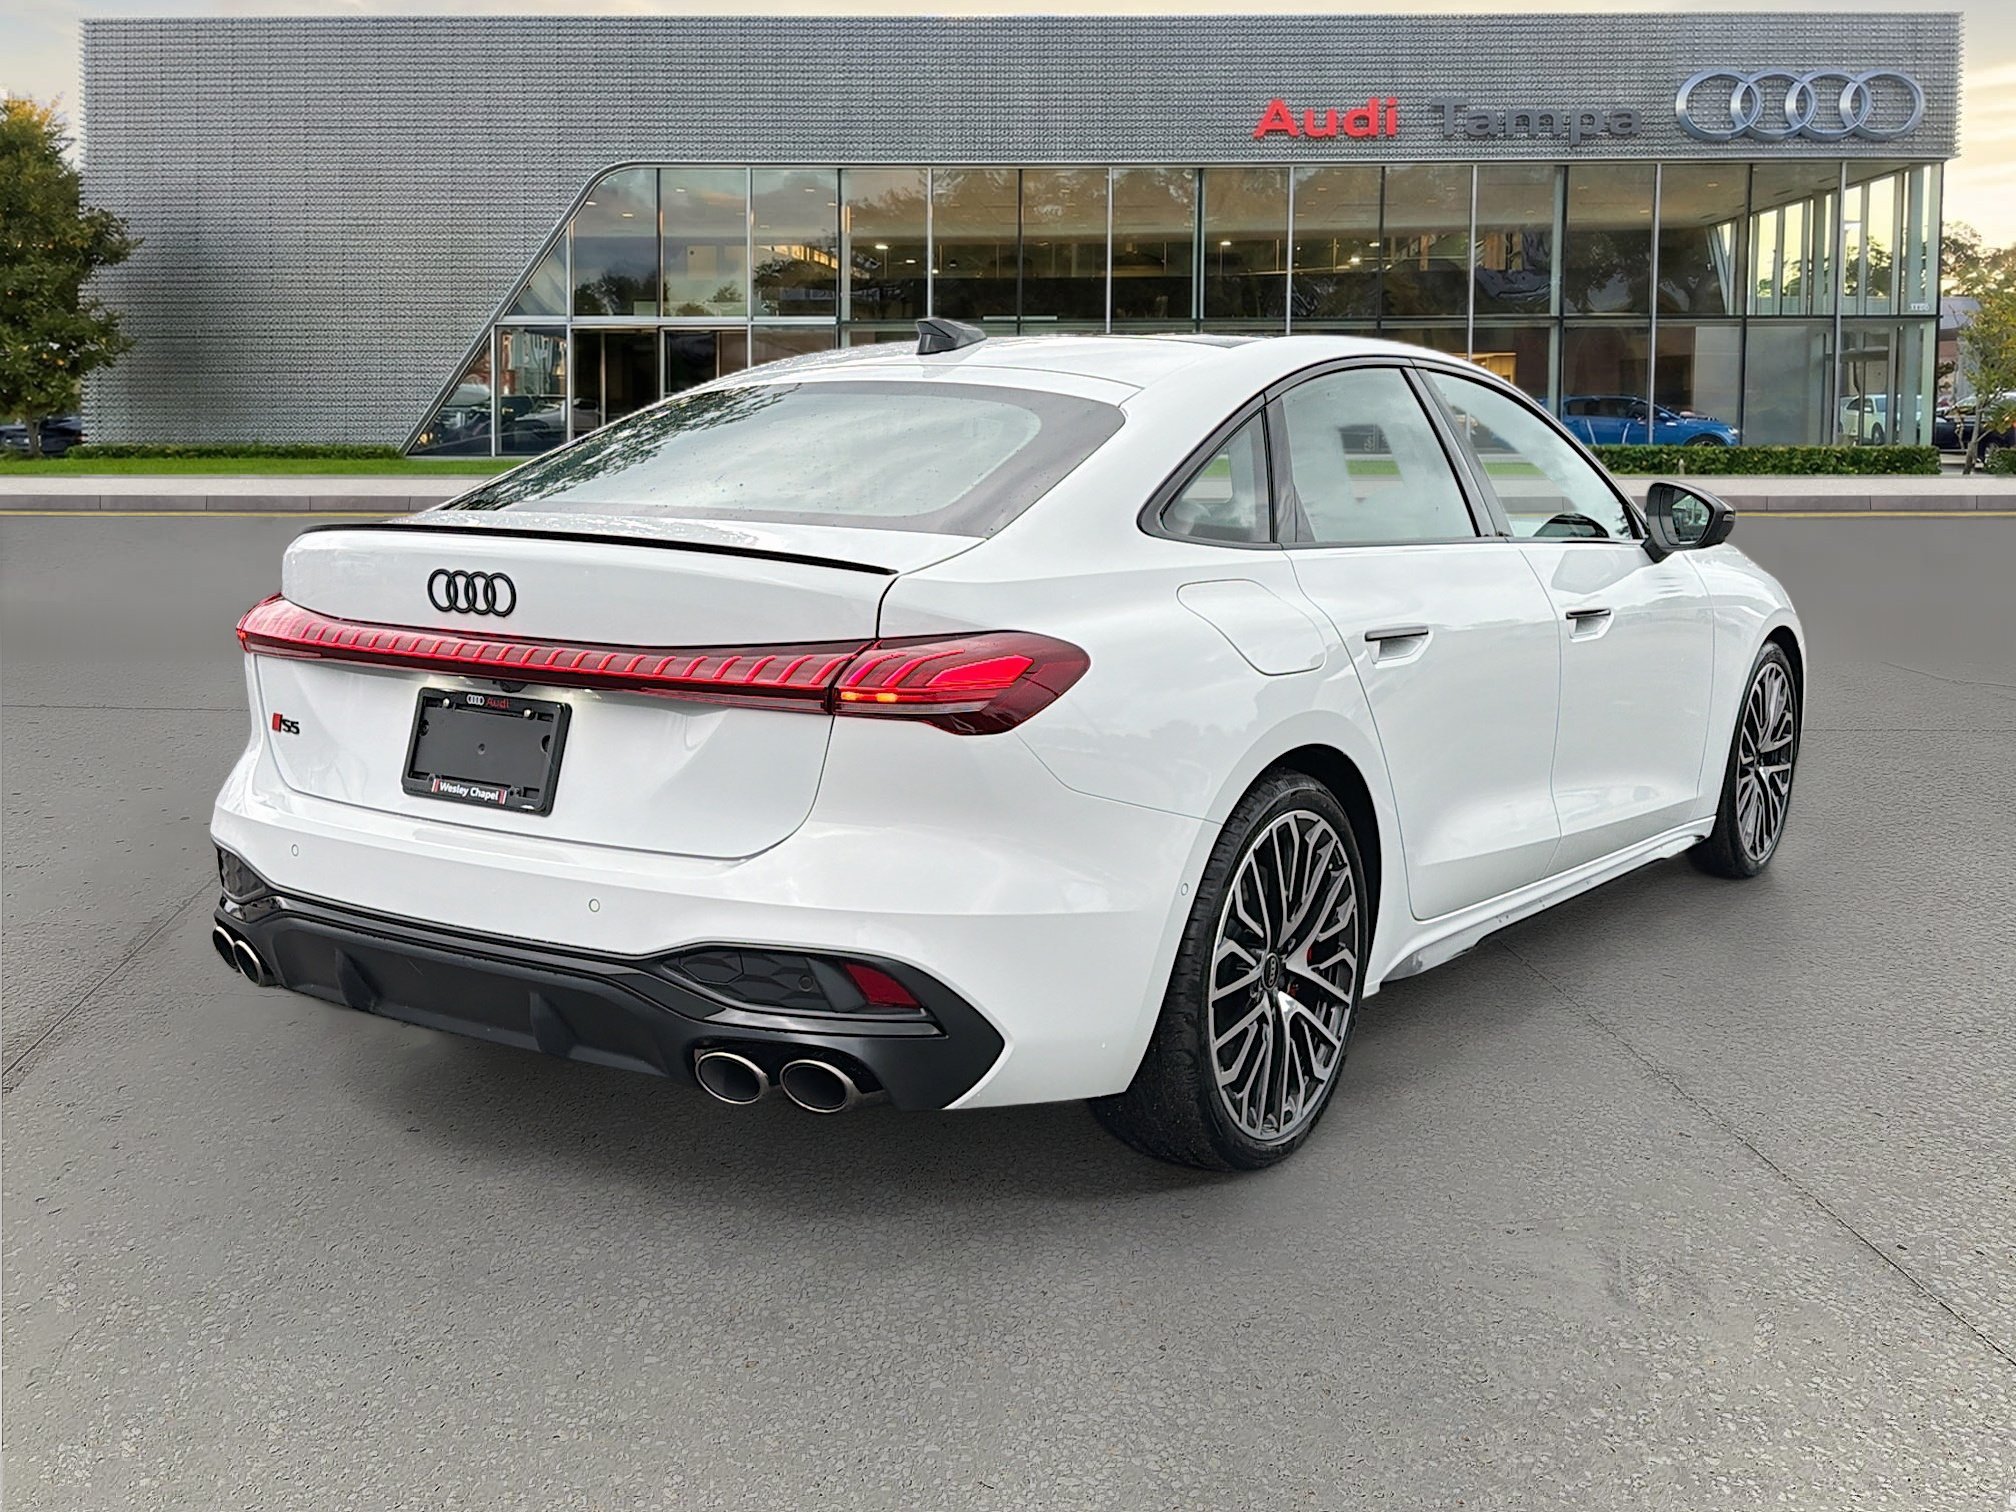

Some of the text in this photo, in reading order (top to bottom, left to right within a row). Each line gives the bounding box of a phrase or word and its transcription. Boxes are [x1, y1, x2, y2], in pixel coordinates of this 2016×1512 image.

[1253, 97, 1641, 147] Audi Tampa
[485, 697, 509, 709] Audi
[281, 718, 300, 735] S5
[439, 781, 499, 801] Wesley Chapel
